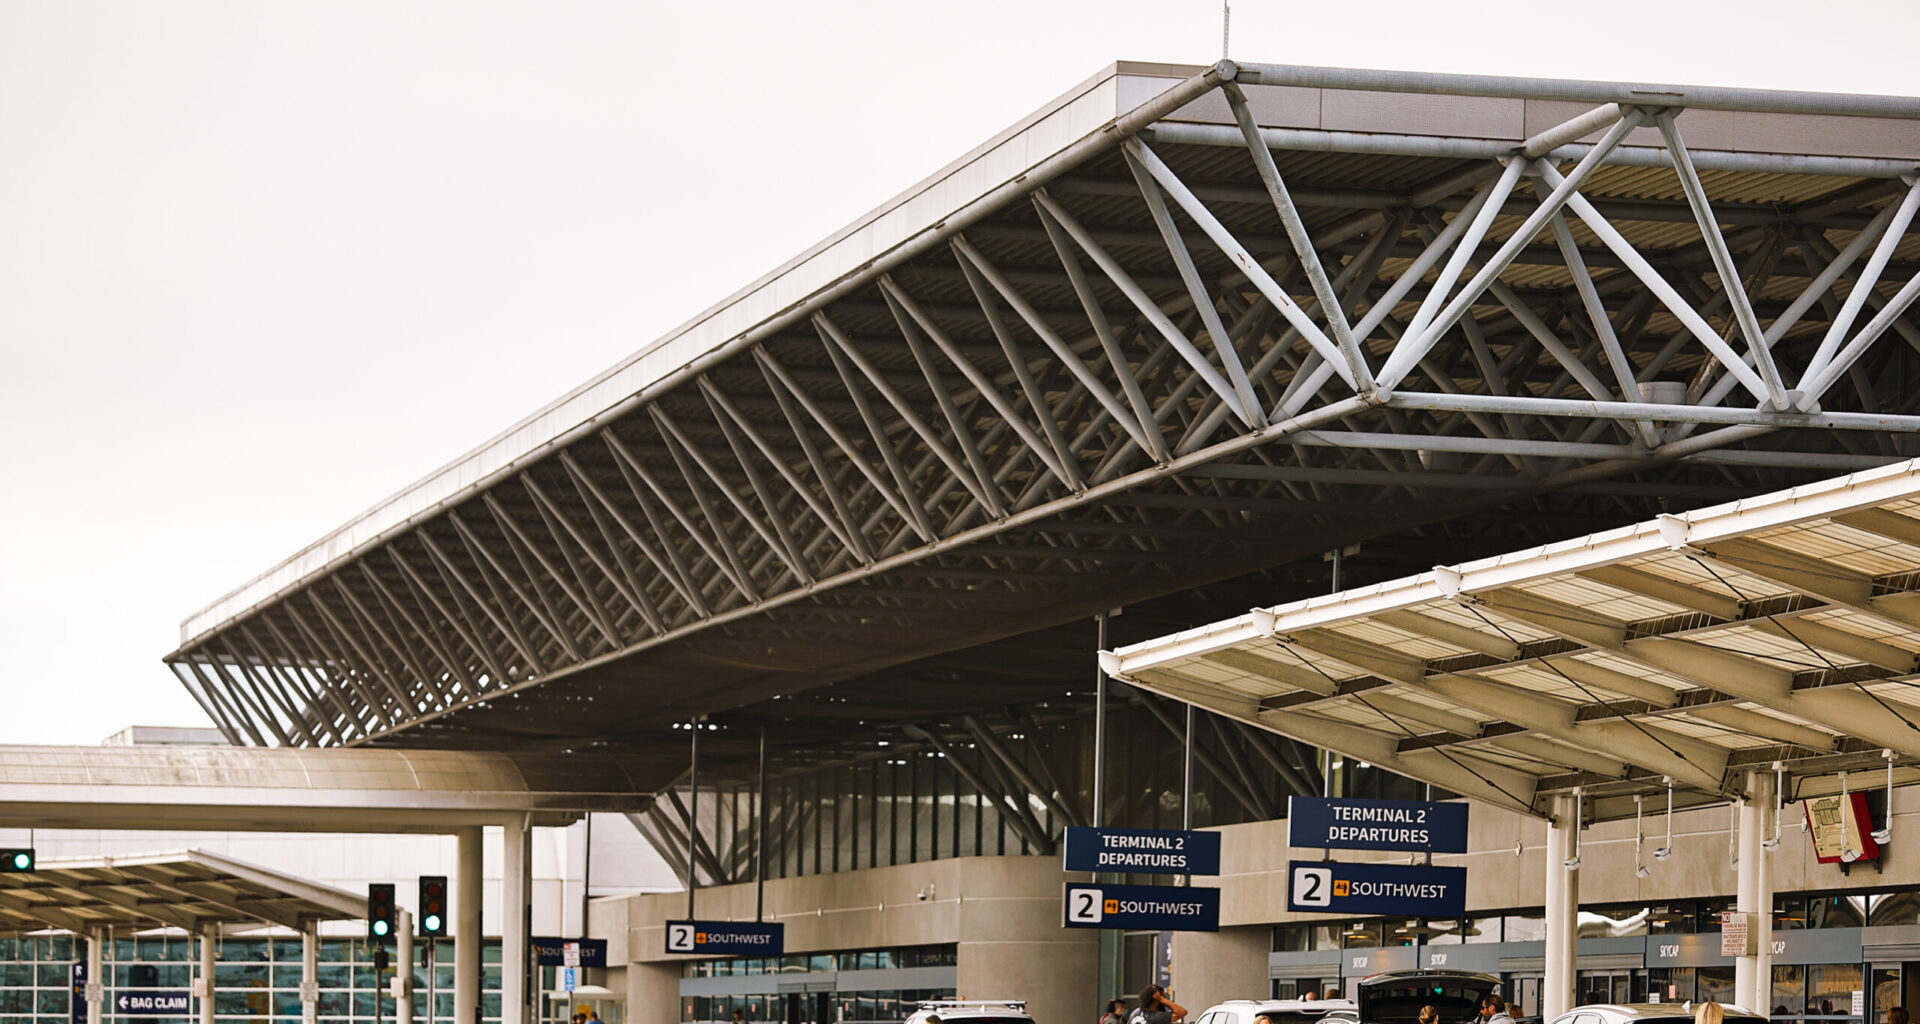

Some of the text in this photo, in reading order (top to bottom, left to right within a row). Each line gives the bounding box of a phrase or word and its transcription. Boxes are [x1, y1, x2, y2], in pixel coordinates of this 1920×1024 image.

[1333, 806, 1426, 823] TERMINAL 2
[1102, 835, 1184, 850] TERMINAL 2
[1328, 826, 1429, 843] DEPARTURES
[1099, 852, 1187, 867] DEPARTURES
[1302, 873, 1447, 901] 2 SOUTHWEST
[1077, 893, 1203, 918] 2 SOUTHWEST
[675, 928, 771, 947] 2 SOUTHWEST
[1660, 944, 1679, 957] SKYCAP
[1771, 941, 1786, 955] YCAP
[130, 997, 187, 1009] BAG CLAIM
